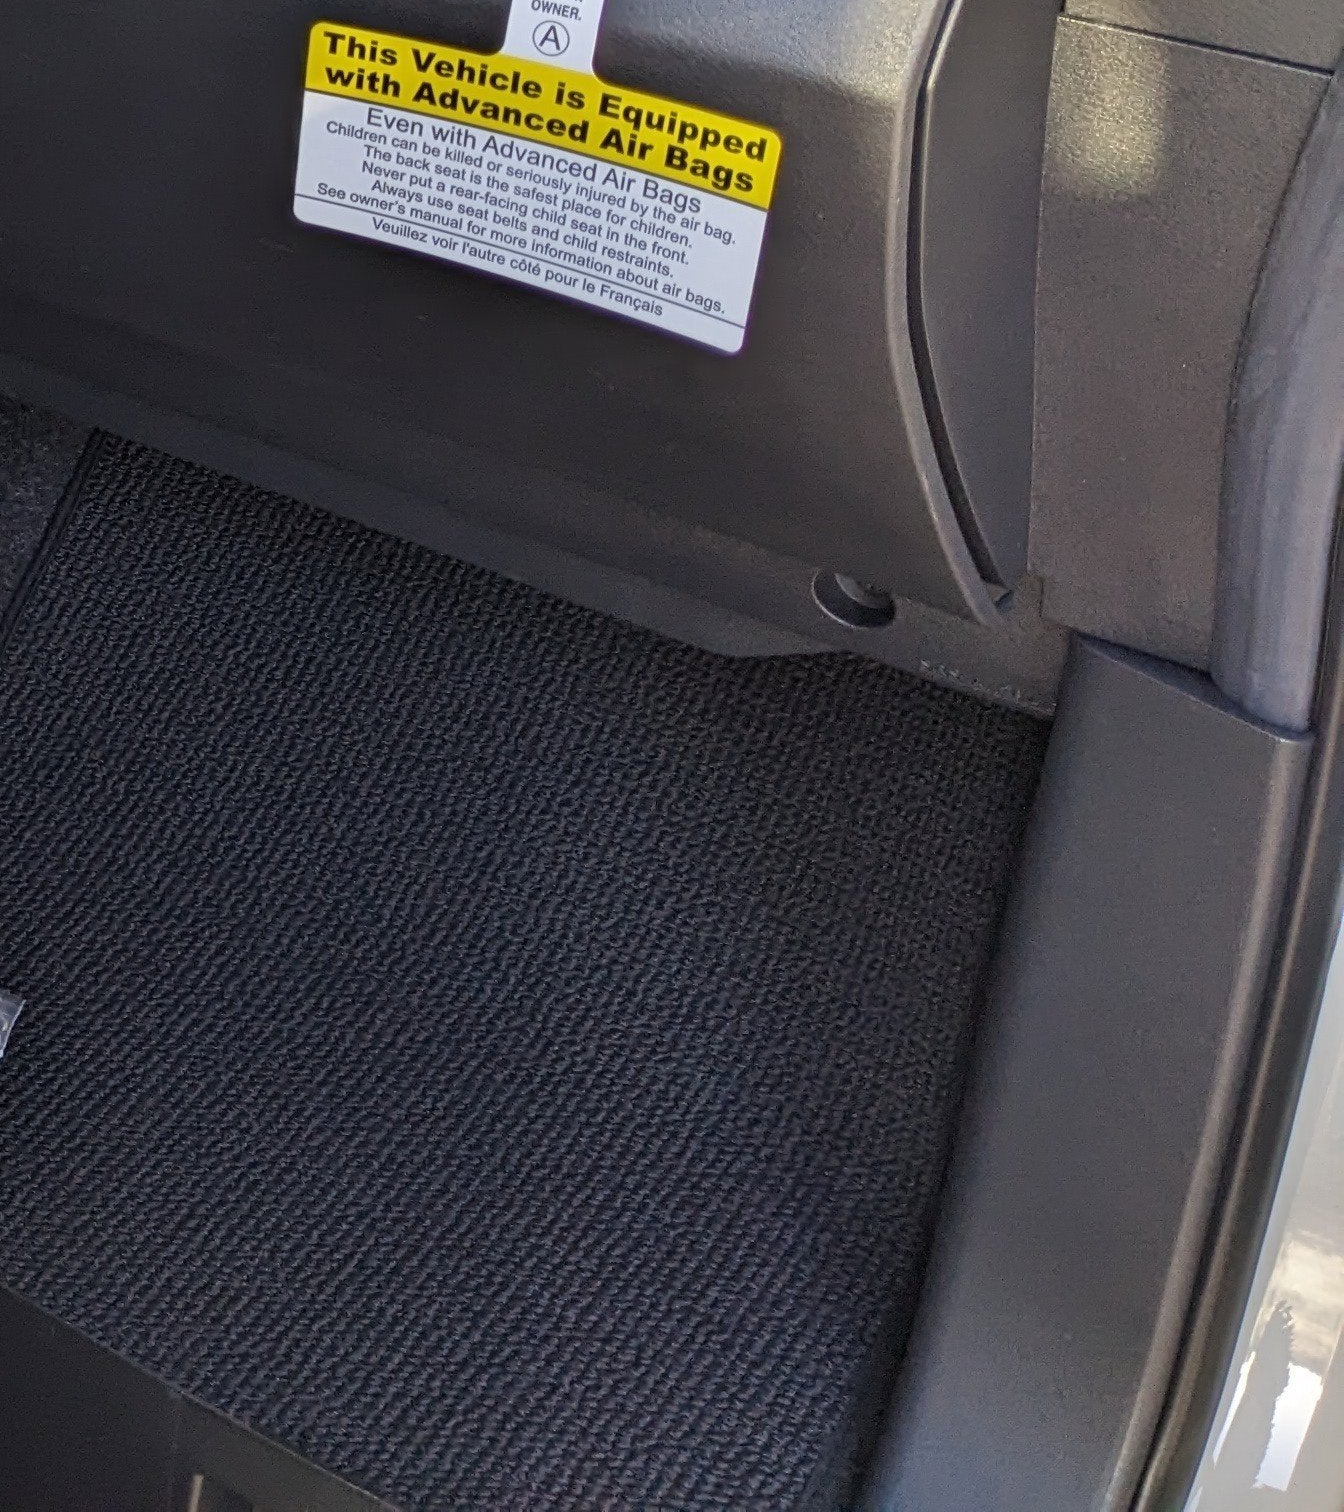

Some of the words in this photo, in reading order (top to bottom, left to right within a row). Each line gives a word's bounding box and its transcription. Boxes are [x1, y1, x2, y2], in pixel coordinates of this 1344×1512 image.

[323, 31, 398, 67] This
[411, 48, 543, 99] Vehicle
[554, 82, 586, 110] is
[598, 92, 768, 163] Equipped
[325, 67, 401, 98] with
[412, 81, 590, 144] Advanced
[599, 127, 654, 161] Air
[664, 144, 754, 193] Bags
[326, 120, 387, 145] Children
[391, 137, 418, 152] can
[422, 142, 441, 157] be
[444, 147, 483, 169] killed
[486, 160, 503, 173] or
[505, 165, 572, 195] seriously
[575, 182, 627, 209] injured
[630, 198, 649, 217] by
[652, 205, 676, 224] the
[680, 216, 701, 232] air
[703, 221, 736, 246] bag.
[361, 160, 406, 182] Never
[409, 173, 433, 189] put
[436, 181, 446, 192] a
[449, 184, 528, 218] rear-facing
[532, 206, 567, 226] child
[570, 218, 603, 237] seat
[606, 226, 619, 243] in
[624, 233, 647, 251] the
[651, 241, 689, 265] front.
[363, 144, 392, 162] The
[395, 152, 431, 172] back
[434, 163, 467, 181] seat
[469, 170, 482, 185] is
[486, 176, 509, 192] the
[513, 185, 559, 206] safest
[562, 198, 602, 219] place
[606, 209, 627, 226] for
[630, 219, 693, 249] children.
[366, 107, 424, 137] Even
[431, 125, 476, 150] with
[481, 135, 598, 182] Advanced
[601, 168, 636, 192] Air
[642, 178, 702, 214] Bags
[317, 182, 346, 200] See
[410, 207, 463, 231] manual
[467, 220, 487, 236] for
[490, 229, 528, 249] more
[531, 239, 613, 276] information
[616, 268, 659, 291] about
[662, 283, 682, 298] air
[685, 288, 725, 314] bags.
[371, 179, 424, 203] Always
[427, 195, 453, 211] use
[457, 202, 489, 221] seat
[492, 210, 528, 232] belts
[531, 225, 559, 242] and
[563, 234, 598, 253] child
[601, 245, 674, 278] restraints.
[372, 216, 428, 243] Veuillez
[432, 235, 459, 251] voir
[462, 241, 506, 265] l'autre
[509, 257, 542, 276] côté
[544, 268, 579, 289] pour
[582, 278, 596, 294] le
[600, 284, 663, 316] Français
